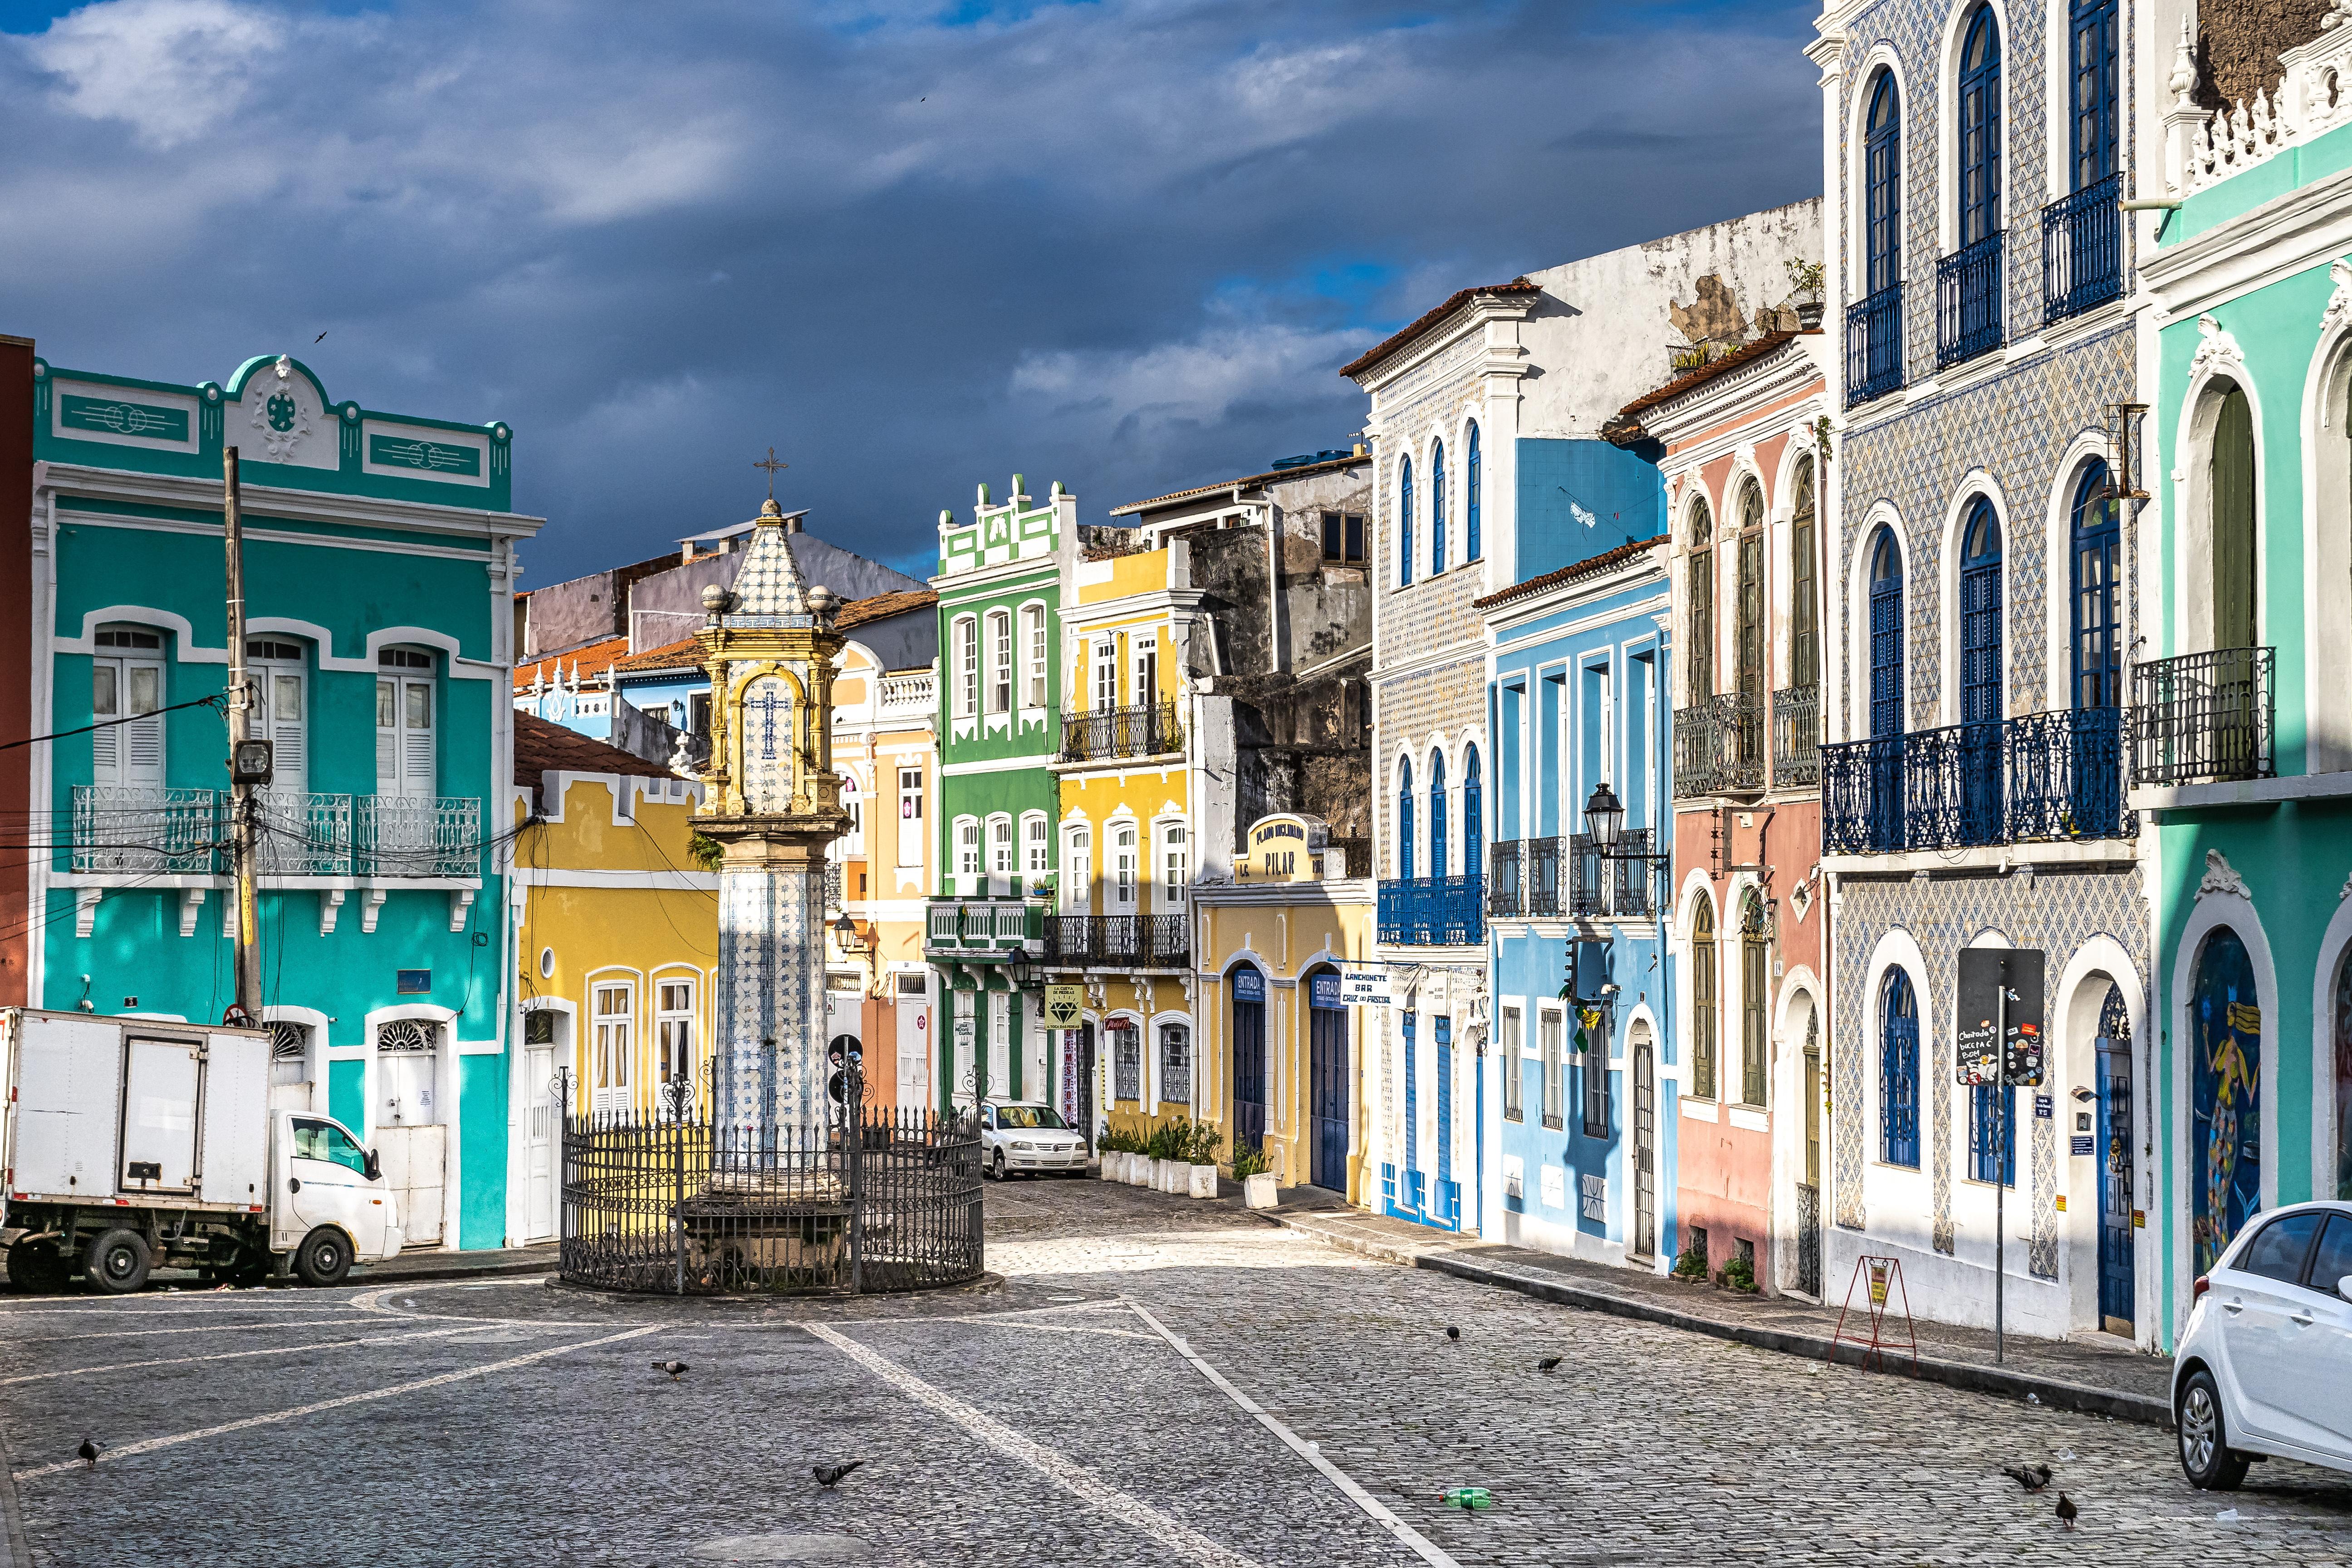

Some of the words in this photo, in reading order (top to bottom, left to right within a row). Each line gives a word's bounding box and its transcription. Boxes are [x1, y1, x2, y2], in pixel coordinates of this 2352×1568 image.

[1256, 826, 1274, 845] PLANO
[1275, 823, 1303, 841] INCLINADO
[1265, 851, 1294, 876] PILAR
[1776, 962, 1781, 975] 19
[1238, 975, 1260, 990] ENTRADA
[1345, 973, 1387, 982] LANCHONETE
[1355, 984, 1372, 992] BAR
[128, 998, 133, 1006] 3
[1343, 994, 1358, 1002] CRUZ
